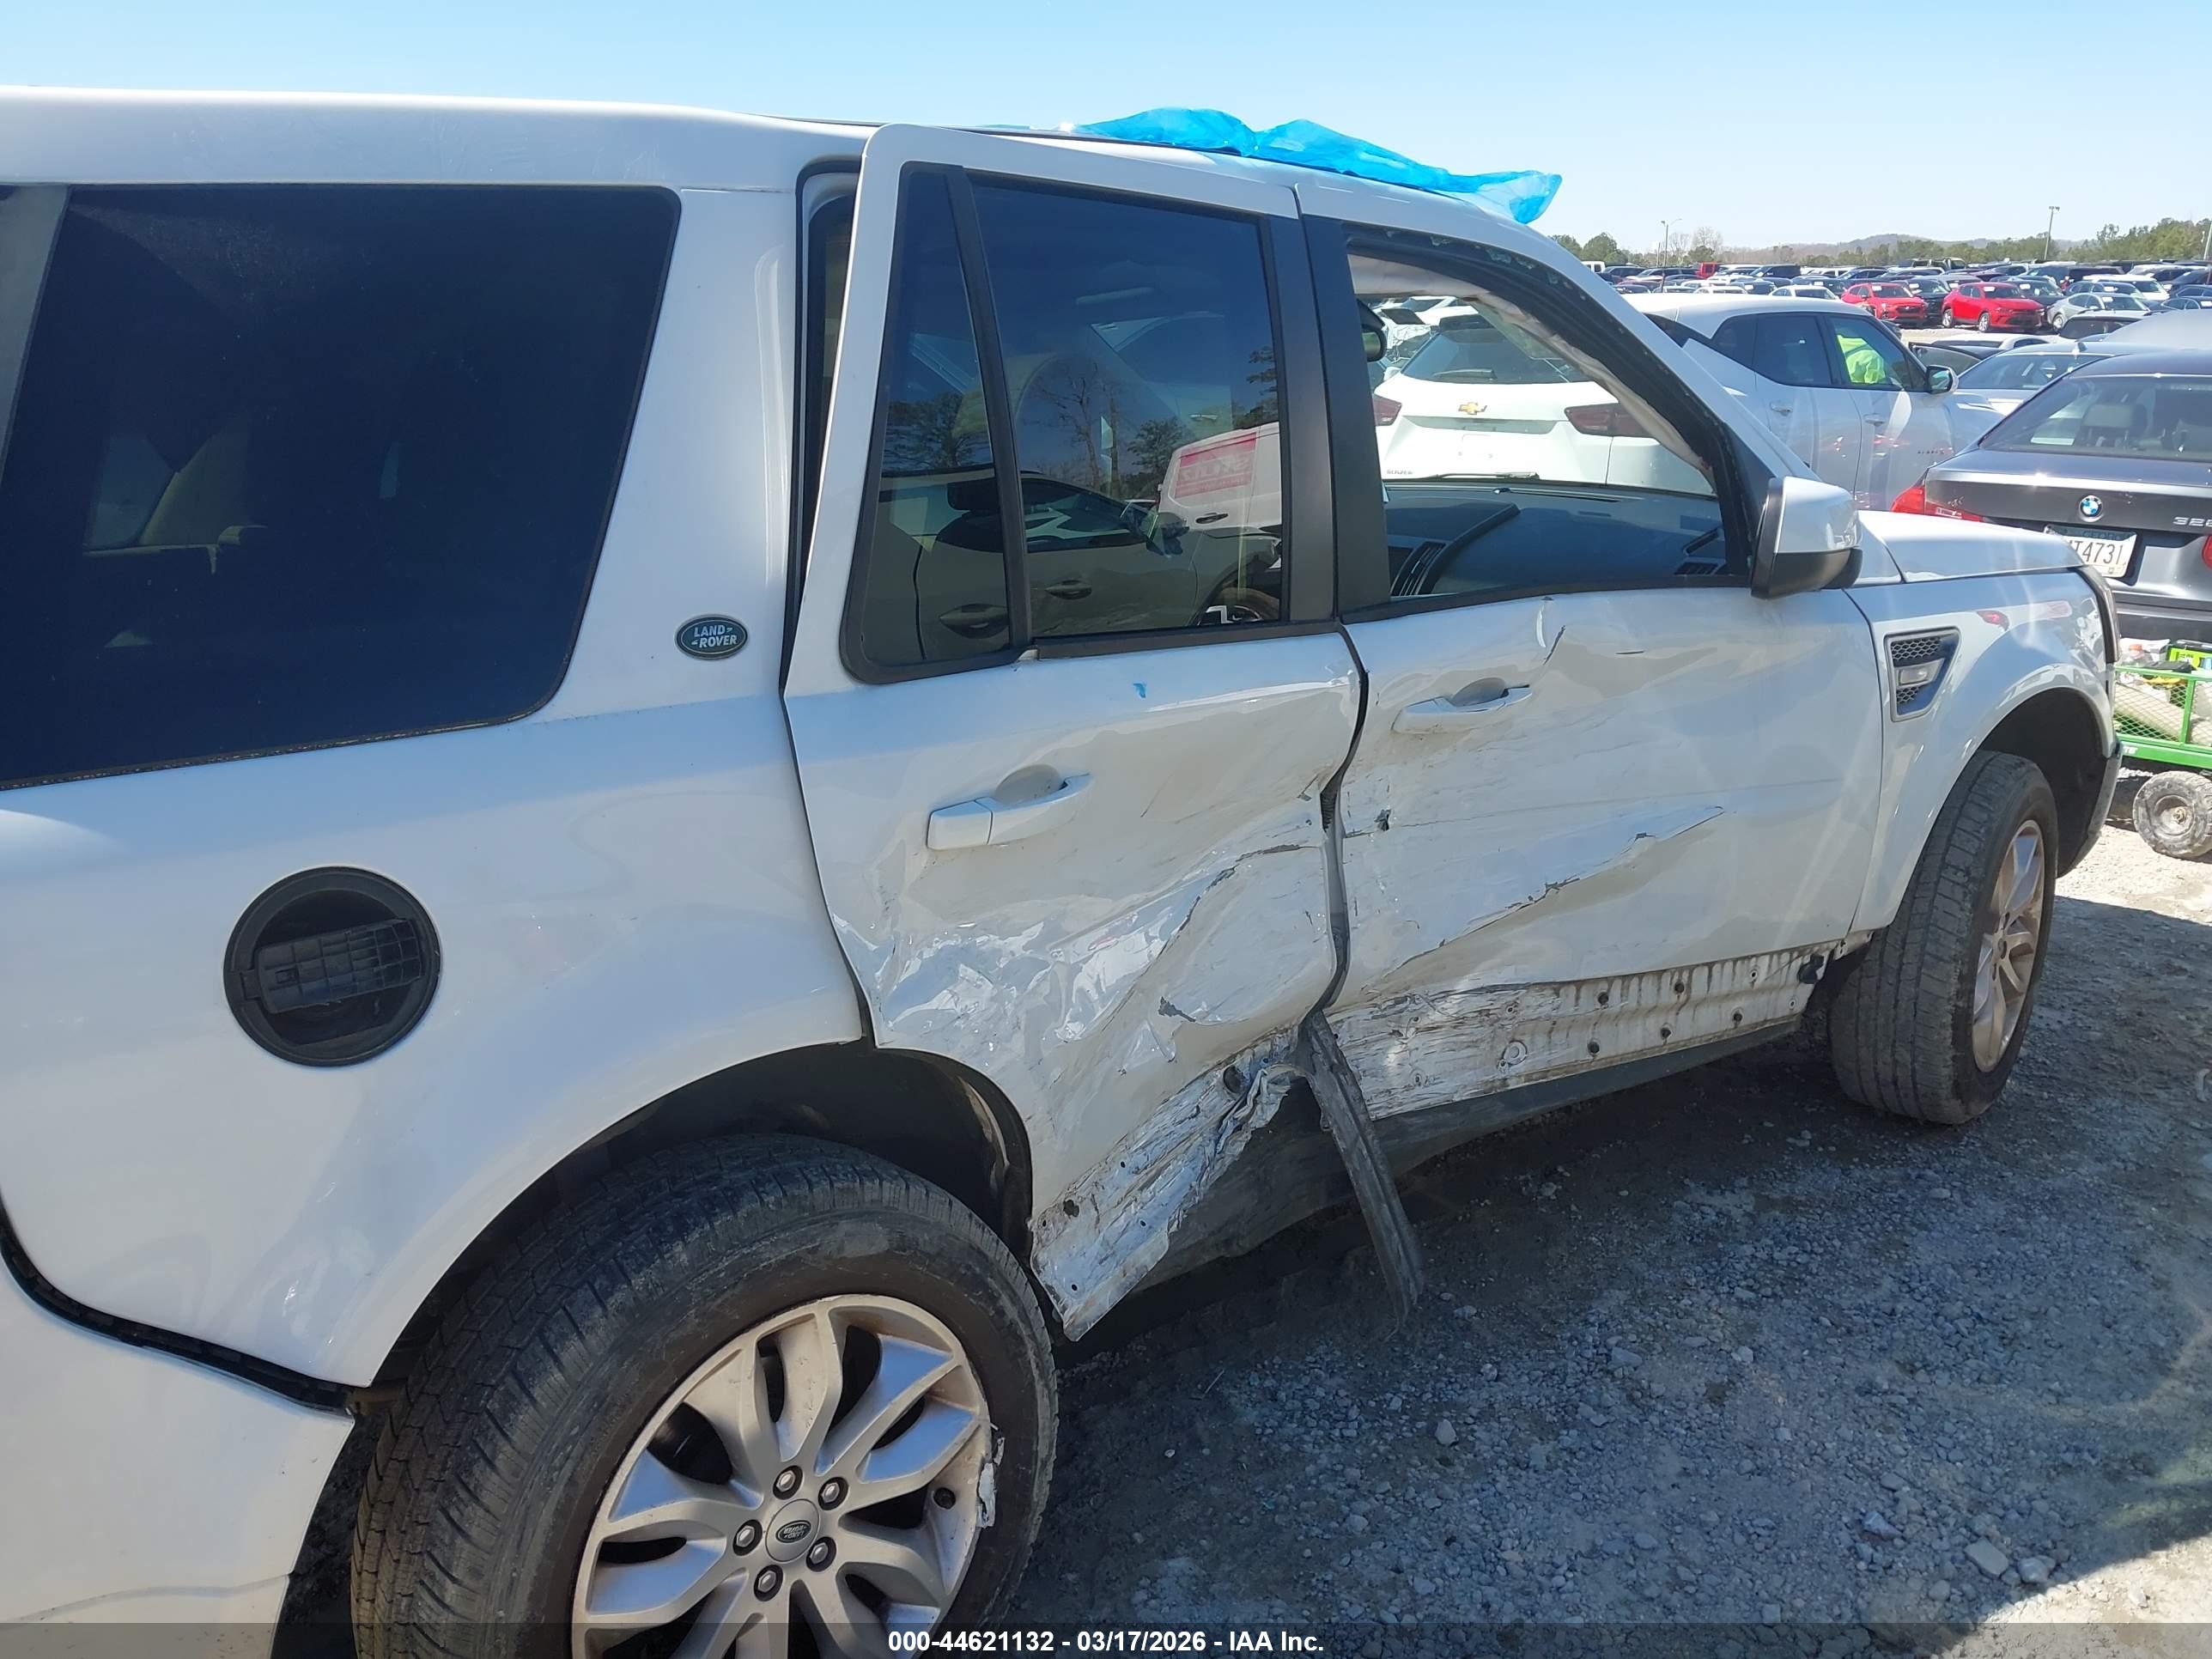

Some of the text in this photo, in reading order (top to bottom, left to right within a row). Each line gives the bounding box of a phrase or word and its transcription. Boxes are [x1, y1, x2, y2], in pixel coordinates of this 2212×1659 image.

[2069, 539, 2124, 565] T4731
[694, 624, 726, 638] LAND
[699, 635, 738, 648] ROVER
